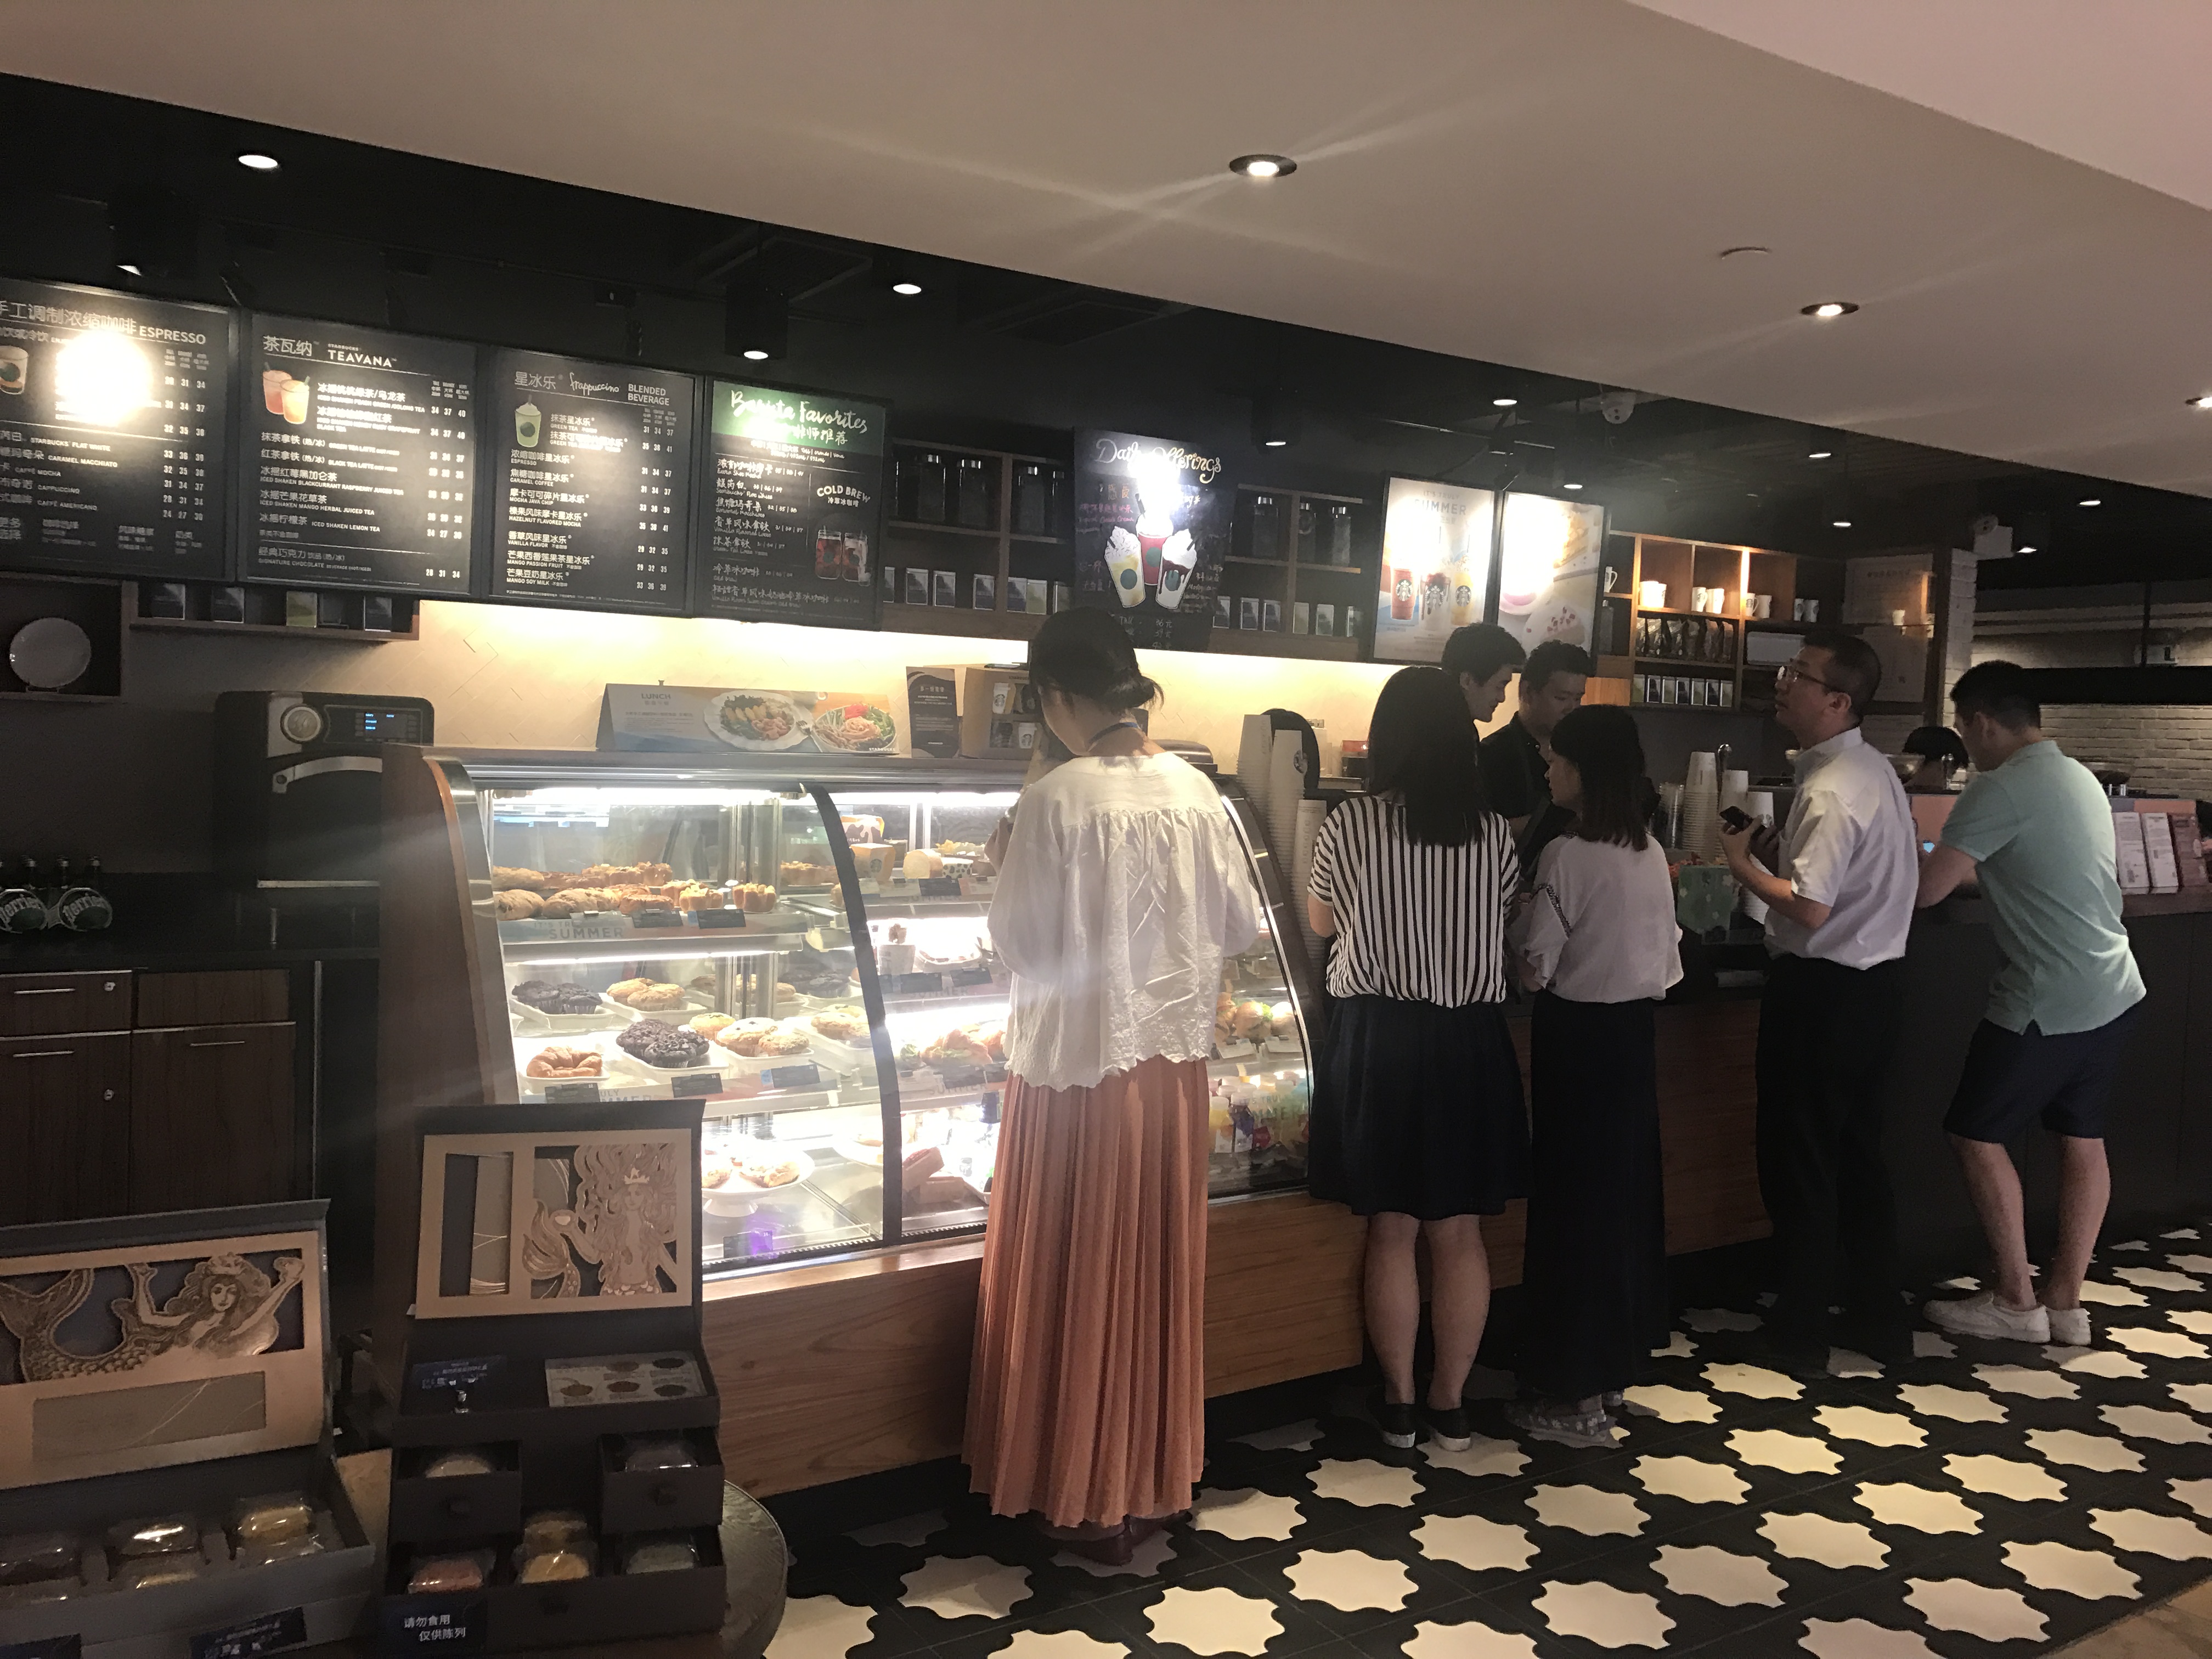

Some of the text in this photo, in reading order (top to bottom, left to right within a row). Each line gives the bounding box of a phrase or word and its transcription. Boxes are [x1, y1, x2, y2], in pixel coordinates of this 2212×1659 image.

[139, 325, 206, 345] ESPRESSO
[263, 335, 313, 357] 茶瓦纳
[515, 371, 556, 390] 星冰乐
[628, 383, 666, 396] BLENDED
[628, 392, 670, 406] BEVERAGE
[180, 402, 188, 410] 34
[458, 410, 466, 418] 40
[799, 401, 867, 433] Favorites
[164, 425, 188, 435] 32 35
[431, 428, 439, 437] 34
[261, 432, 300, 445] 抹茶拿铁
[48, 455, 118, 467] CARAMEL MACCHIATO
[164, 450, 173, 459] 33
[261, 448, 300, 461] 红茶拿铁
[456, 455, 465, 463] 37
[511, 449, 570, 465] 浓缩咖啡星冰乐
[511, 458, 537, 466] ESPRESSO
[164, 465, 188, 475] 32 35
[510, 468, 569, 483] 焦糖咖啡星冰乐
[298, 480, 341, 489] BLACKCURRANT
[342, 484, 373, 492] RASPBERRY
[261, 489, 327, 504] 冰摇芒果花草茶
[510, 488, 585, 504] 摩卡可可碎片星冰乐
[816, 485, 871, 503] COLD BREW
[509, 506, 582, 521] 榛果风味摩卡星冰乐
[509, 515, 535, 523] HAZELNUT
[509, 531, 567, 545] 香草风味星冰乐
[507, 550, 591, 565] 芒果西番莲果茶星冰乐
[453, 571, 460, 579] 34
[507, 567, 564, 584] 芒果豆奶星冰乐
[549, 927, 624, 940] SUMMER
[404, 1614, 450, 1628] 请勿食用
[418, 1627, 466, 1641] 仅供陈列
